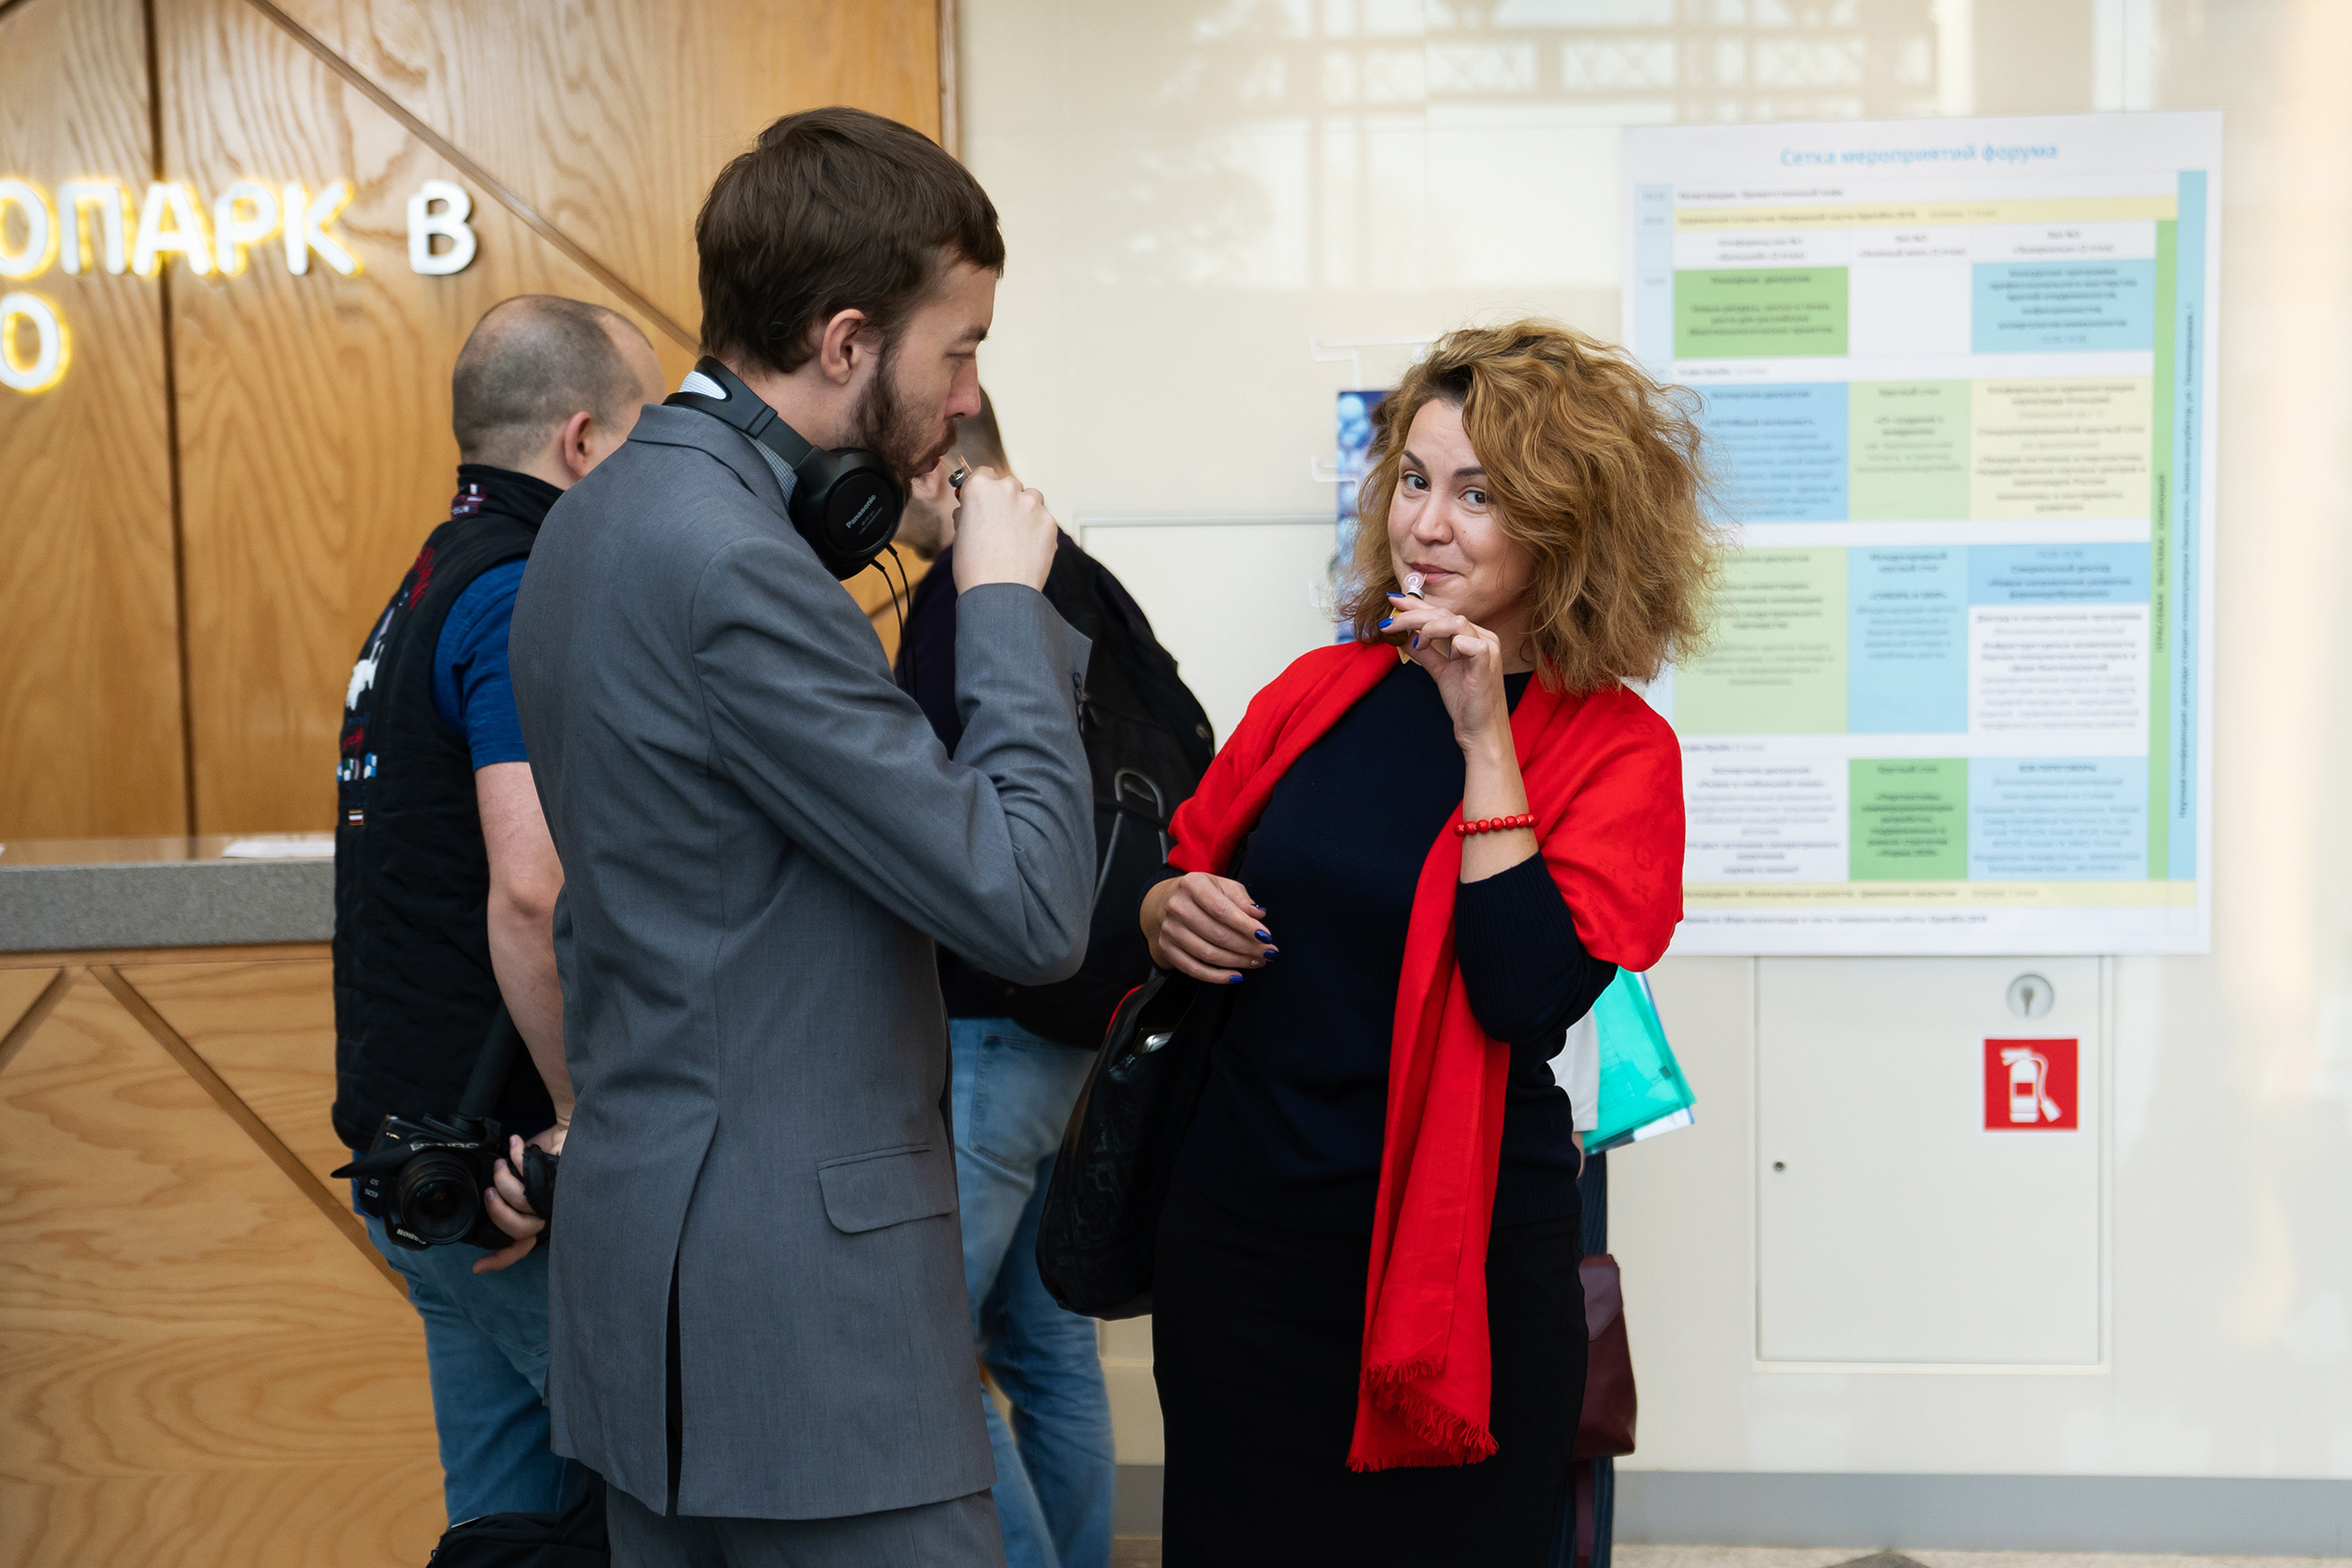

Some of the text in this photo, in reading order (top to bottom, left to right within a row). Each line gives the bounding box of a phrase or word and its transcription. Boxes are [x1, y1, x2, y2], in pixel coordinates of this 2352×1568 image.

[1780, 142, 2058, 167] Сетка мероприятий форума
[0, 179, 477, 277] ОПАРК В
[0, 291, 60, 391] О
[846, 494, 876, 529] Panasonic
[364, 1188, 379, 1198] EOS
